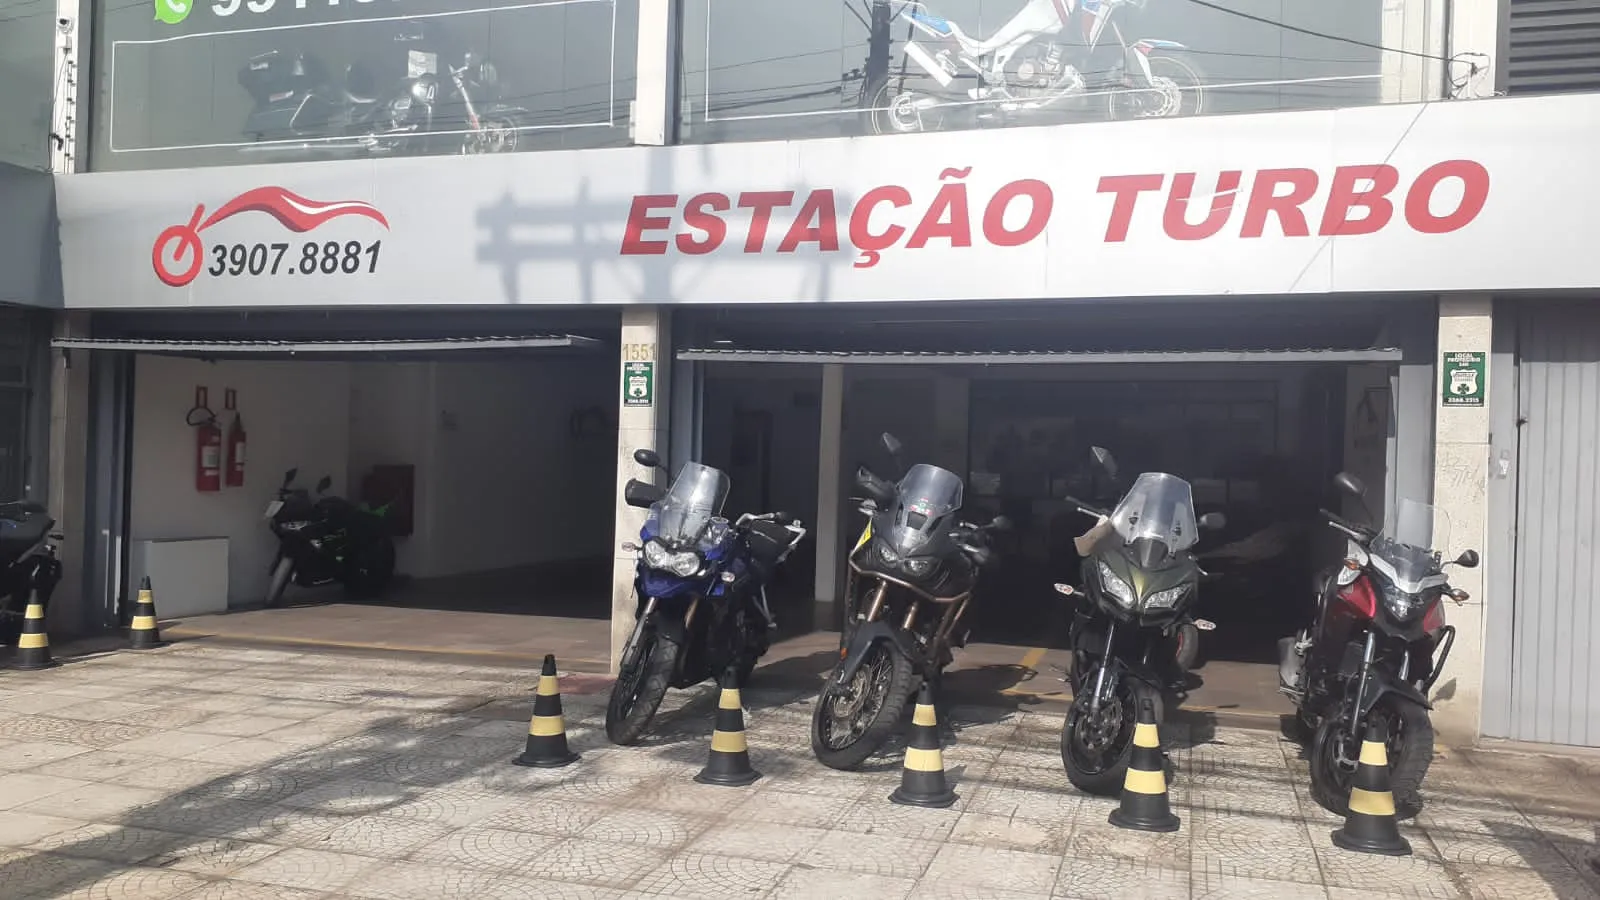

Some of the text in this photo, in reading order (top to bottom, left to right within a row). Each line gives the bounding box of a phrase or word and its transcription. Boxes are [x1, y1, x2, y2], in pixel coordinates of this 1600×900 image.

[620, 159, 1490, 268] ESTAÇÃO TURBO
[208, 239, 381, 277] 3907.8881
[622, 343, 656, 361] 1551
